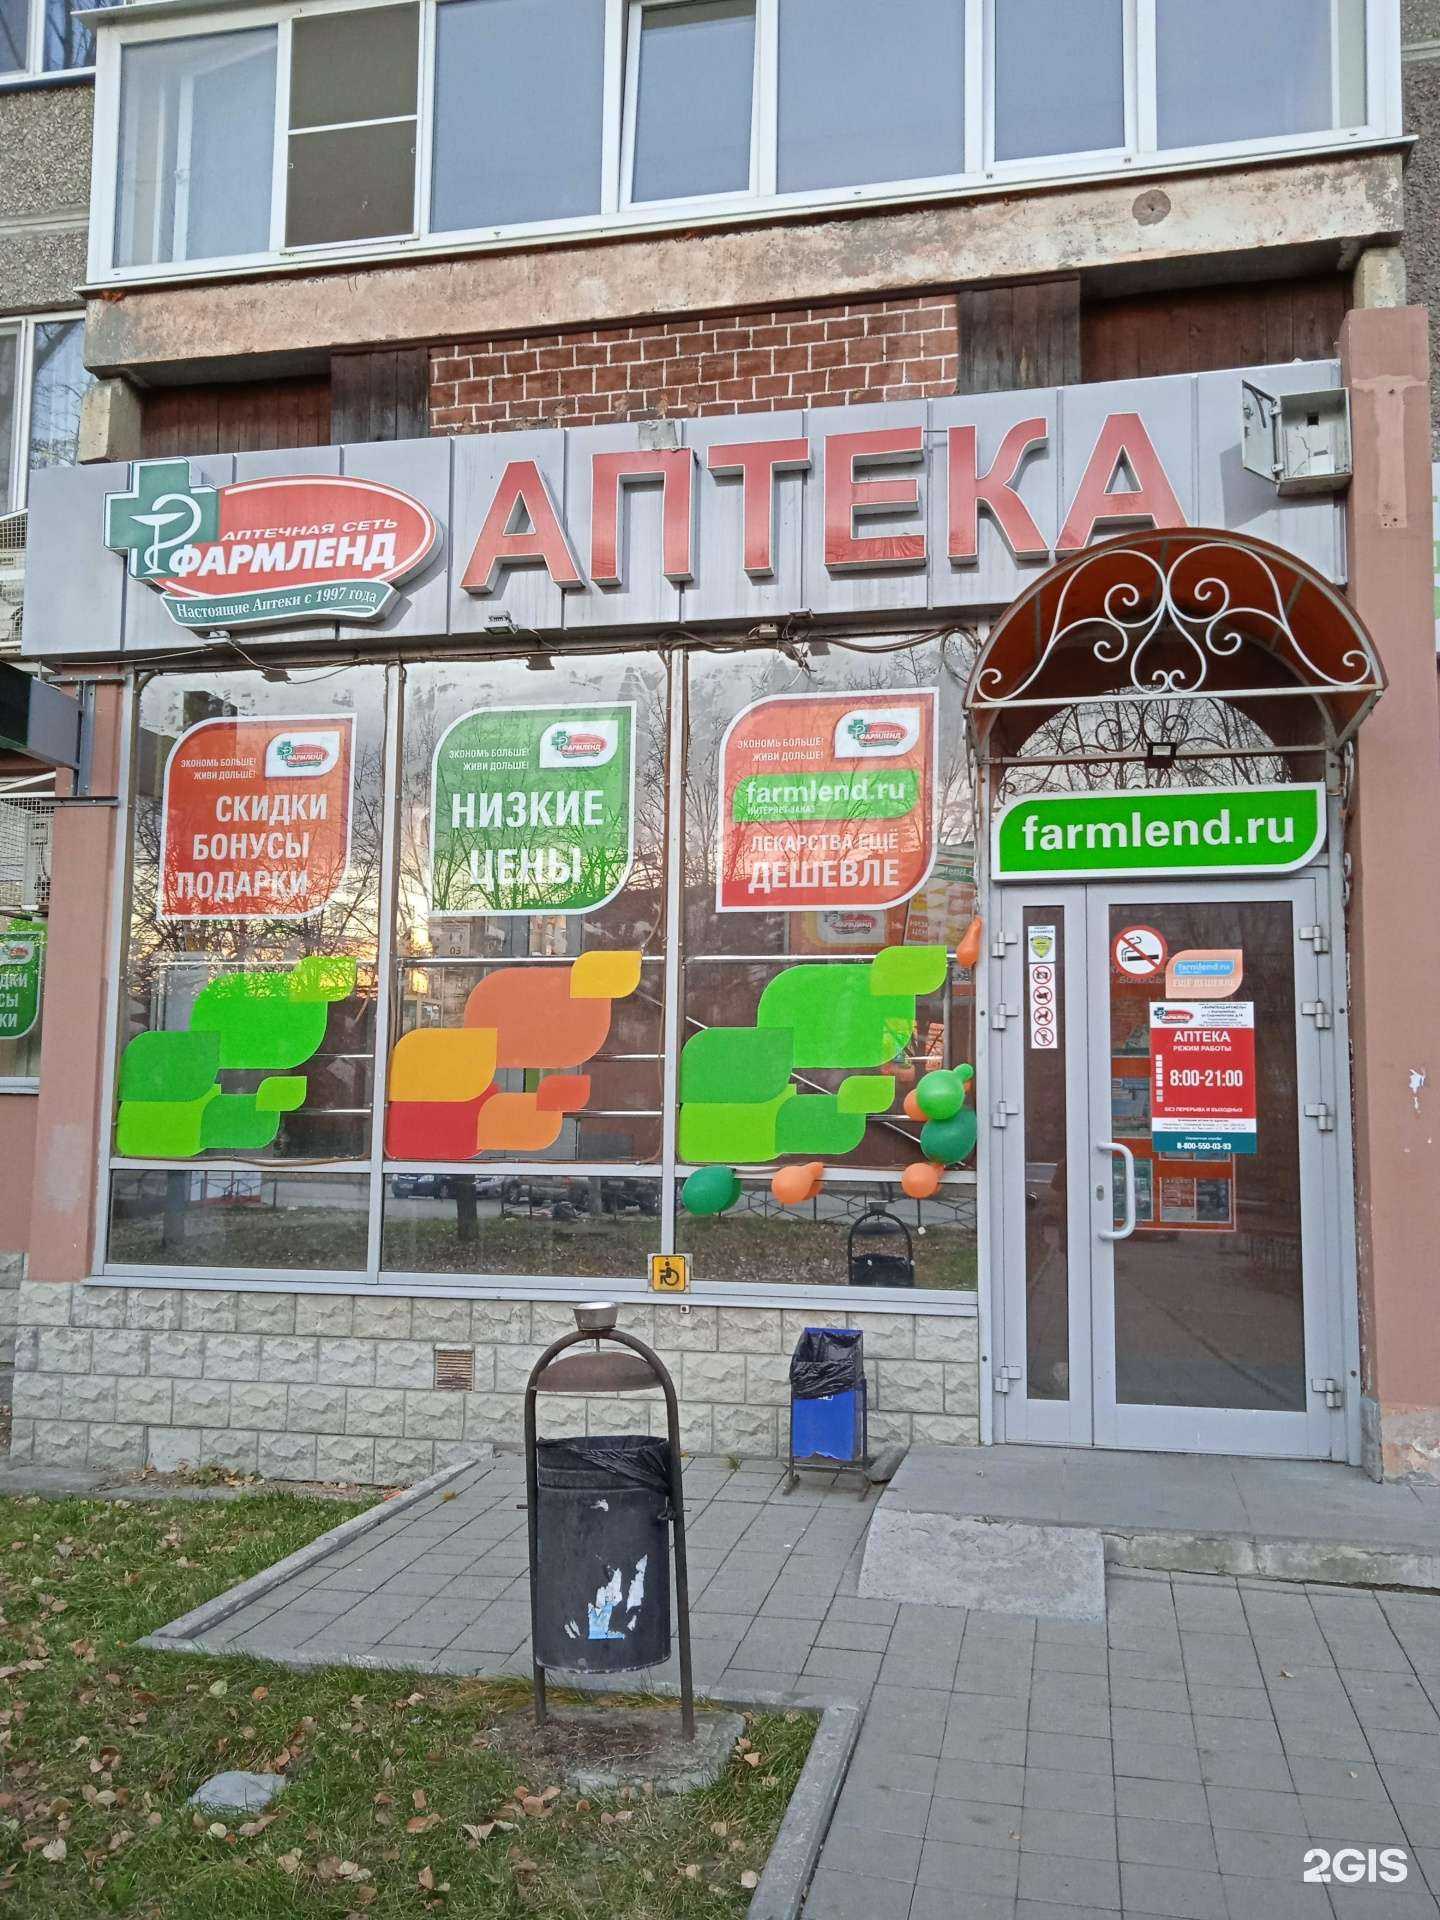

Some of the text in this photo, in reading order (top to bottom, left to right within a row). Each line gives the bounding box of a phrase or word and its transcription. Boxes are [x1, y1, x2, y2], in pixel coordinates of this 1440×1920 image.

[459, 411, 1187, 594] АПТЕКА
[220, 519, 398, 542] АПТЕЧНАЯ СЕТЬ
[168, 532, 396, 577] ФАРМЛЕНД
[176, 587, 377, 620] Настоящие Аптеки с 1997 года
[449, 750, 489, 759] ЭКОНОМЬ
[737, 737, 825, 748] ЭКОНОМЬ БОЛЬШЕ!
[181, 759, 218, 768] ЭКОНОМЬ
[463, 762, 488, 771] ЖИВИ
[752, 751, 825, 762] ЖИВИ ДОЛЬШЕ!
[194, 771, 217, 779] ЖИВИ
[747, 779, 905, 804] farmlend.ru
[215, 793, 328, 826] СКИДКИ
[451, 790, 604, 828] НИЗКИЕ
[751, 833, 852, 852] ЛЕКАРСТВА
[1022, 809, 1294, 851] farmlend.ru
[193, 832, 309, 860] БОНУСЫ
[470, 848, 582, 891] ЦЕНЫ
[748, 859, 899, 894] ДЕШЕВЛЕ
[177, 869, 308, 903] ПОДАРКИ
[1173, 1031, 1231, 1042] АПТЕКА
[1170, 1069, 1243, 1087] 8:00-21:00
